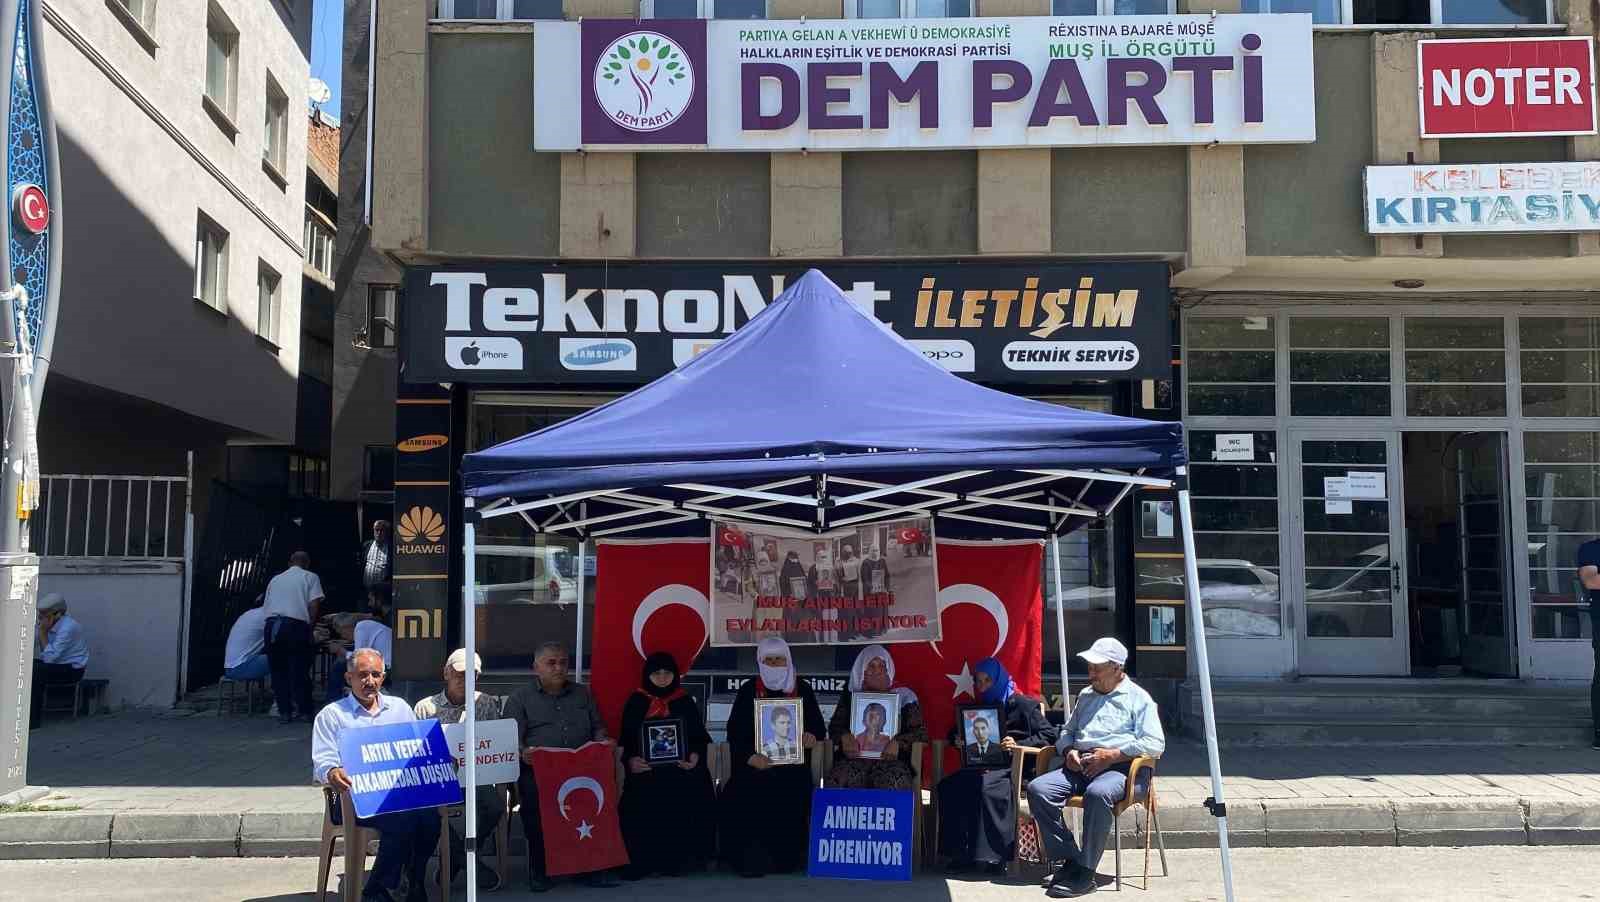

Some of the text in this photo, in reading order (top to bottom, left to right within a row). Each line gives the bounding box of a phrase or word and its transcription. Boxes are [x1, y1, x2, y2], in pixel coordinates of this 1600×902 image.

[740, 29, 788, 41] PARTIYA
[792, 28, 834, 41] GELAN
[839, 29, 848, 40] A
[740, 42, 1012, 61] HALKLARIN EŞİTLİK VE DEMOKRASİ PARTİSİ
[1049, 39, 1216, 61] MUŞ İL ÖRGÜTÜ
[741, 33, 1263, 130] DEM PARTİ
[1432, 67, 1583, 106] NOTER
[616, 110, 639, 127] DEM
[430, 272, 1139, 339] TeknoNt İLETİŞİM
[481, 346, 509, 359] iPhone
[1007, 346, 1136, 363] TEKNİK SERVİS
[396, 544, 445, 555] HUAWEI
[361, 742, 394, 764] ARTIK
[392, 738, 427, 759] YETER
[823, 805, 896, 831] ANNELER
[818, 833, 903, 866] DİRENİYOR
